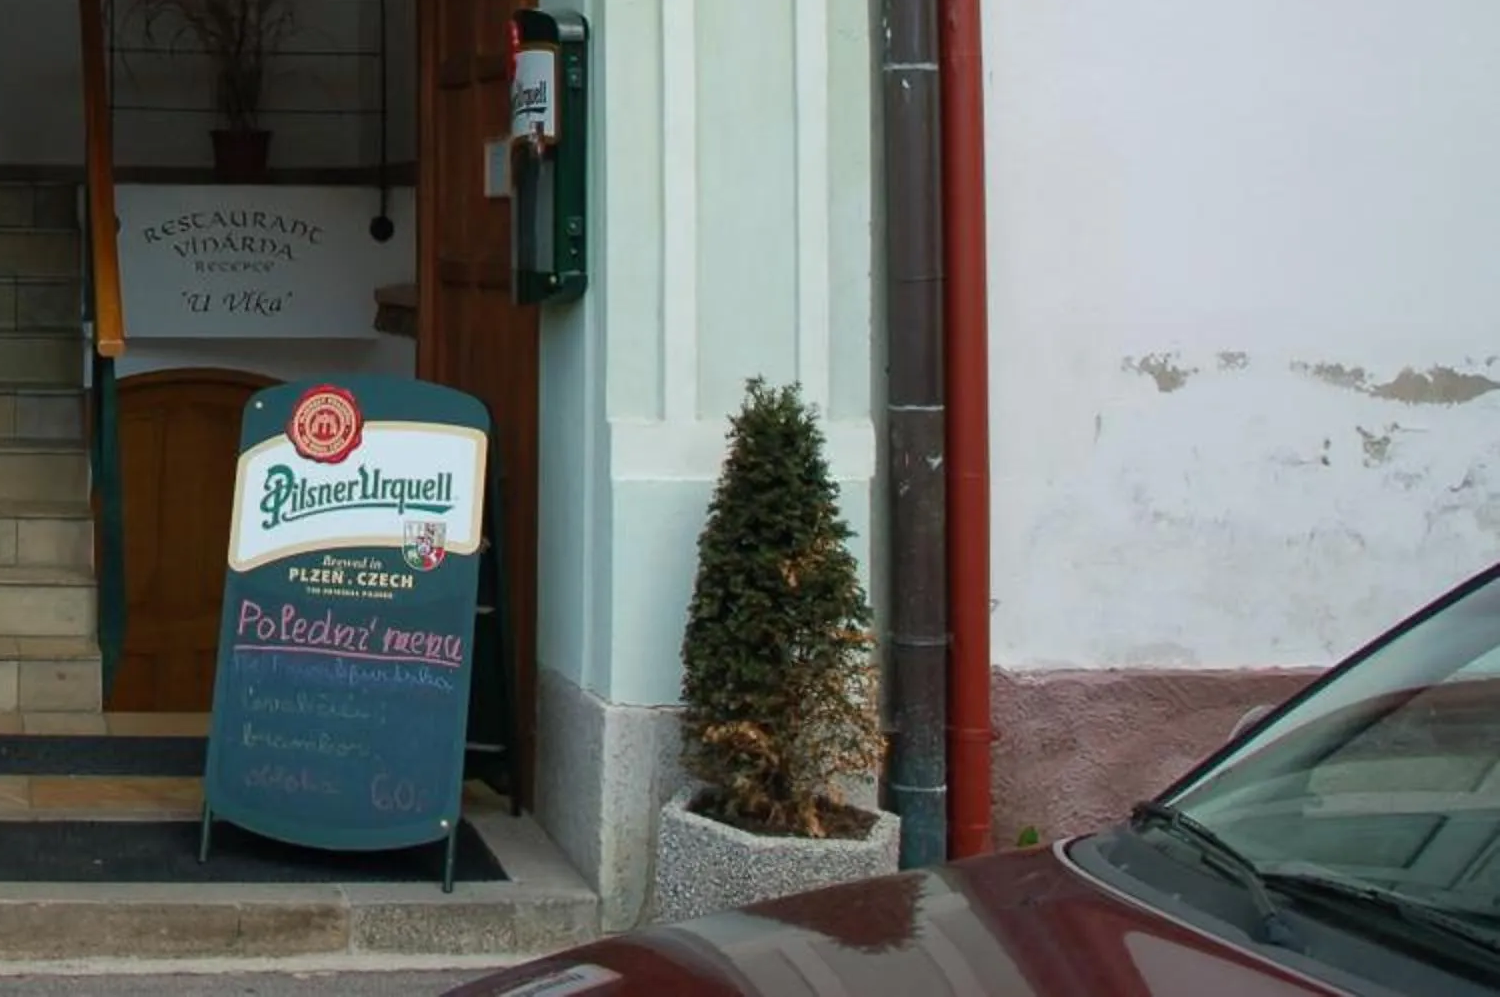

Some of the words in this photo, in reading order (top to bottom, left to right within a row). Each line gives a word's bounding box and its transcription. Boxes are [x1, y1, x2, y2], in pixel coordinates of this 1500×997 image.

[144, 211, 325, 244] RESTAURANT
[260, 464, 359, 530] Pilsner
[358, 464, 453, 515] Urquell
[357, 571, 414, 588] CZECH
